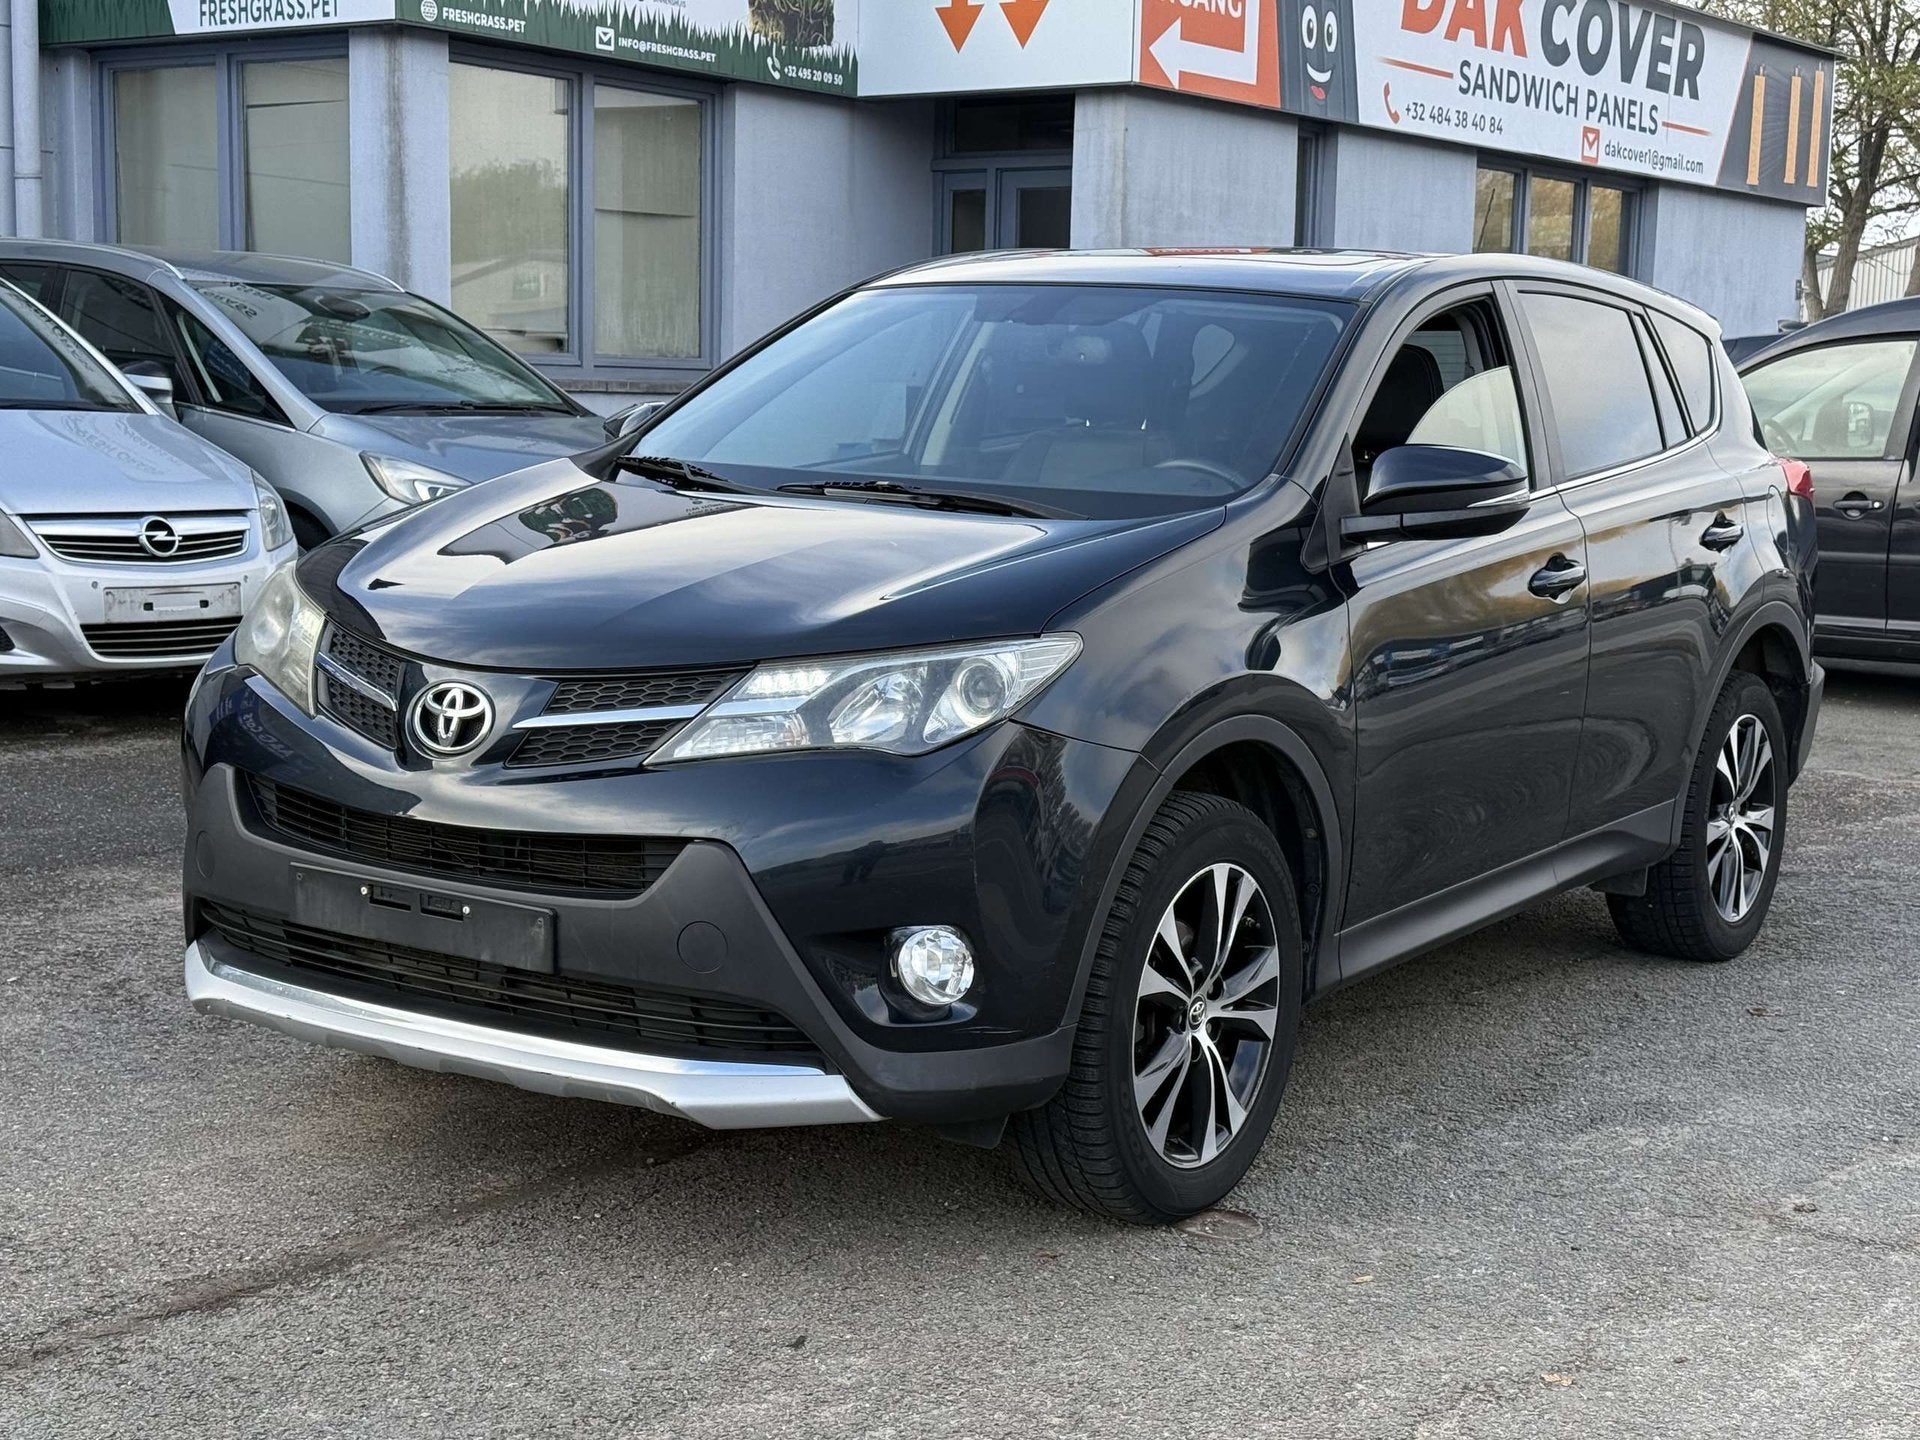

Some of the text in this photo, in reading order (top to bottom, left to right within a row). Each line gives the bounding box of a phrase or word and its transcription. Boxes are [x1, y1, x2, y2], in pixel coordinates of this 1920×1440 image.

[199, 0, 337, 27] FRESHGRASS.PET
[442, 7, 526, 33] FRESHGRASS.PET
[618, 37, 717, 63] INFO@FRESHGRASS.PET
[1540, 0, 1705, 101] COVER
[784, 65, 843, 86] +32 495 20 09 50
[1458, 59, 1659, 136] SANDWICH PANELS
[1405, 102, 1503, 135] +32 484 38 40 84
[1604, 139, 1704, 175] dakcover1@gmail.com
